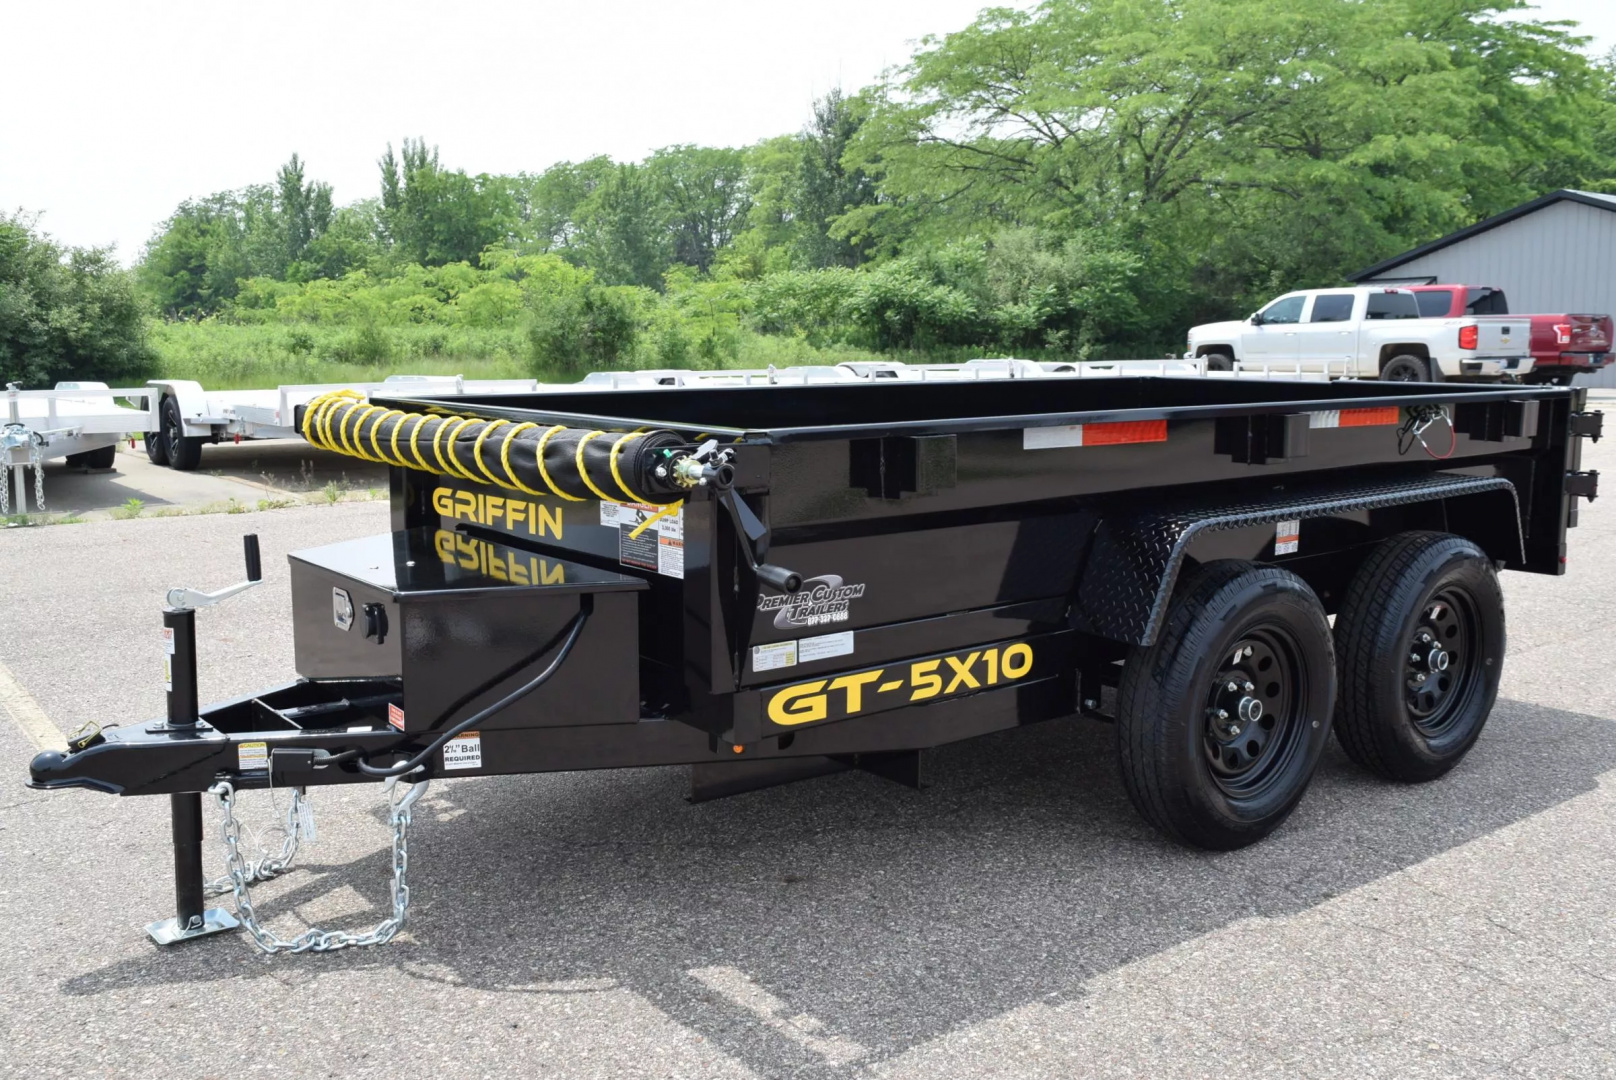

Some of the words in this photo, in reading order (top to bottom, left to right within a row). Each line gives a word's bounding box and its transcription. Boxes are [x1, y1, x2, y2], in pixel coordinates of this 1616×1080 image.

[432, 487, 563, 540] GRIFFIN
[811, 584, 866, 603] CUSTOM
[787, 600, 849, 621] TRAILERS
[767, 643, 1034, 726] GT-5X10
[461, 744, 480, 752] Ball
